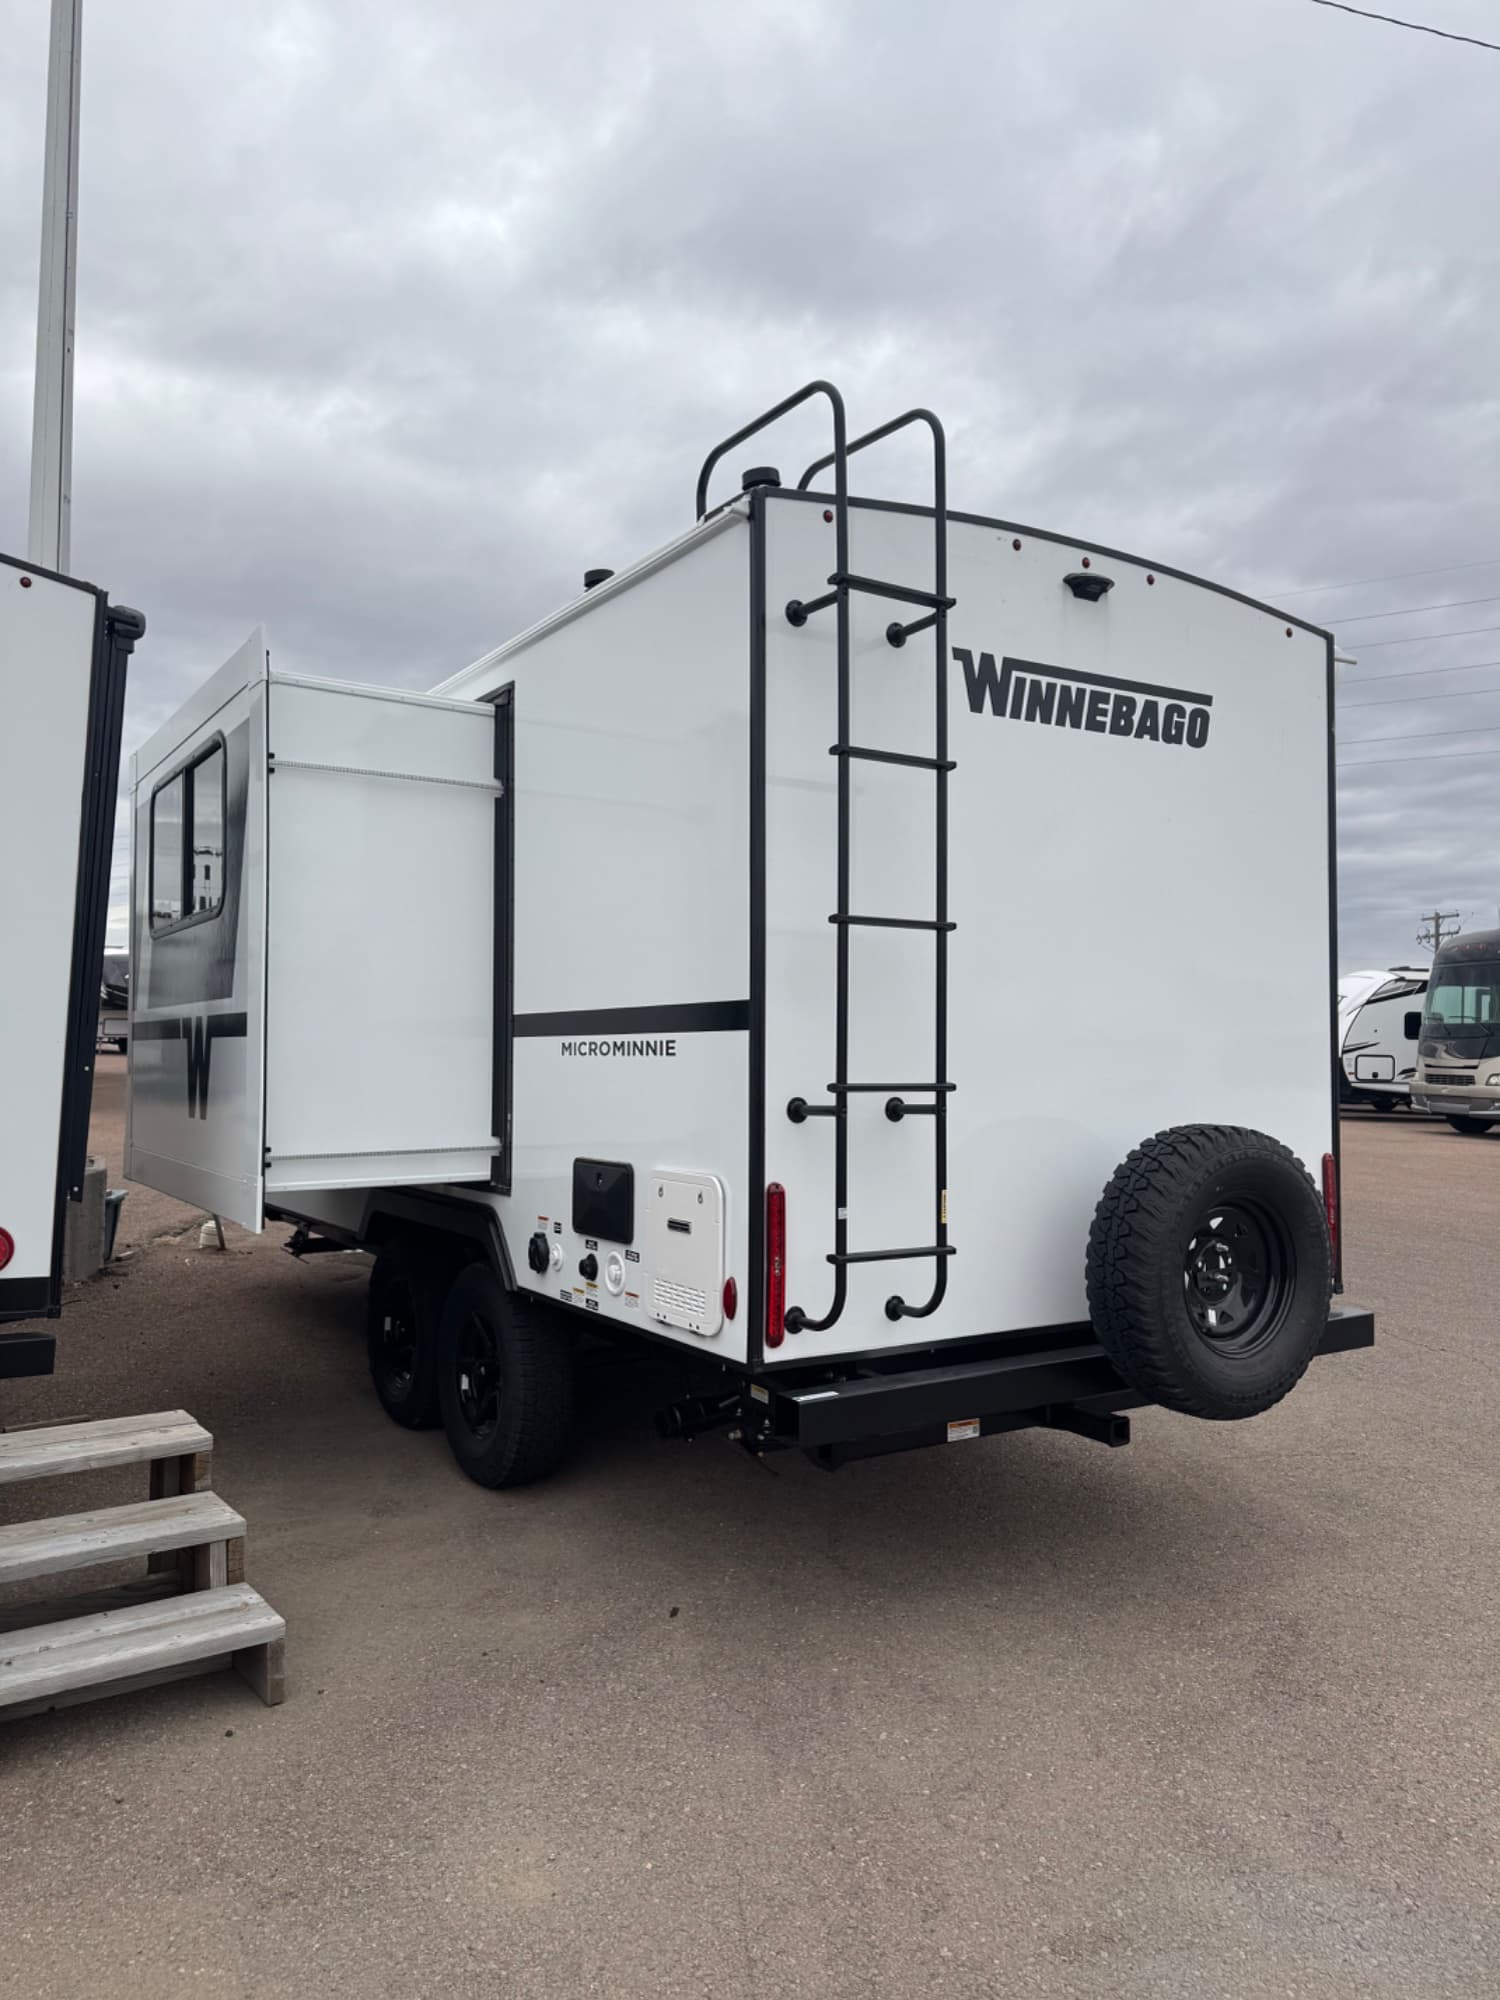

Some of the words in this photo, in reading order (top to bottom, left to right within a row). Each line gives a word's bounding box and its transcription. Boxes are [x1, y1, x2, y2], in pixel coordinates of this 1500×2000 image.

[952, 647, 1213, 749] WINNEBAGO
[181, 1014, 212, 1121] W
[561, 1039, 677, 1057] MICROMINNIE
